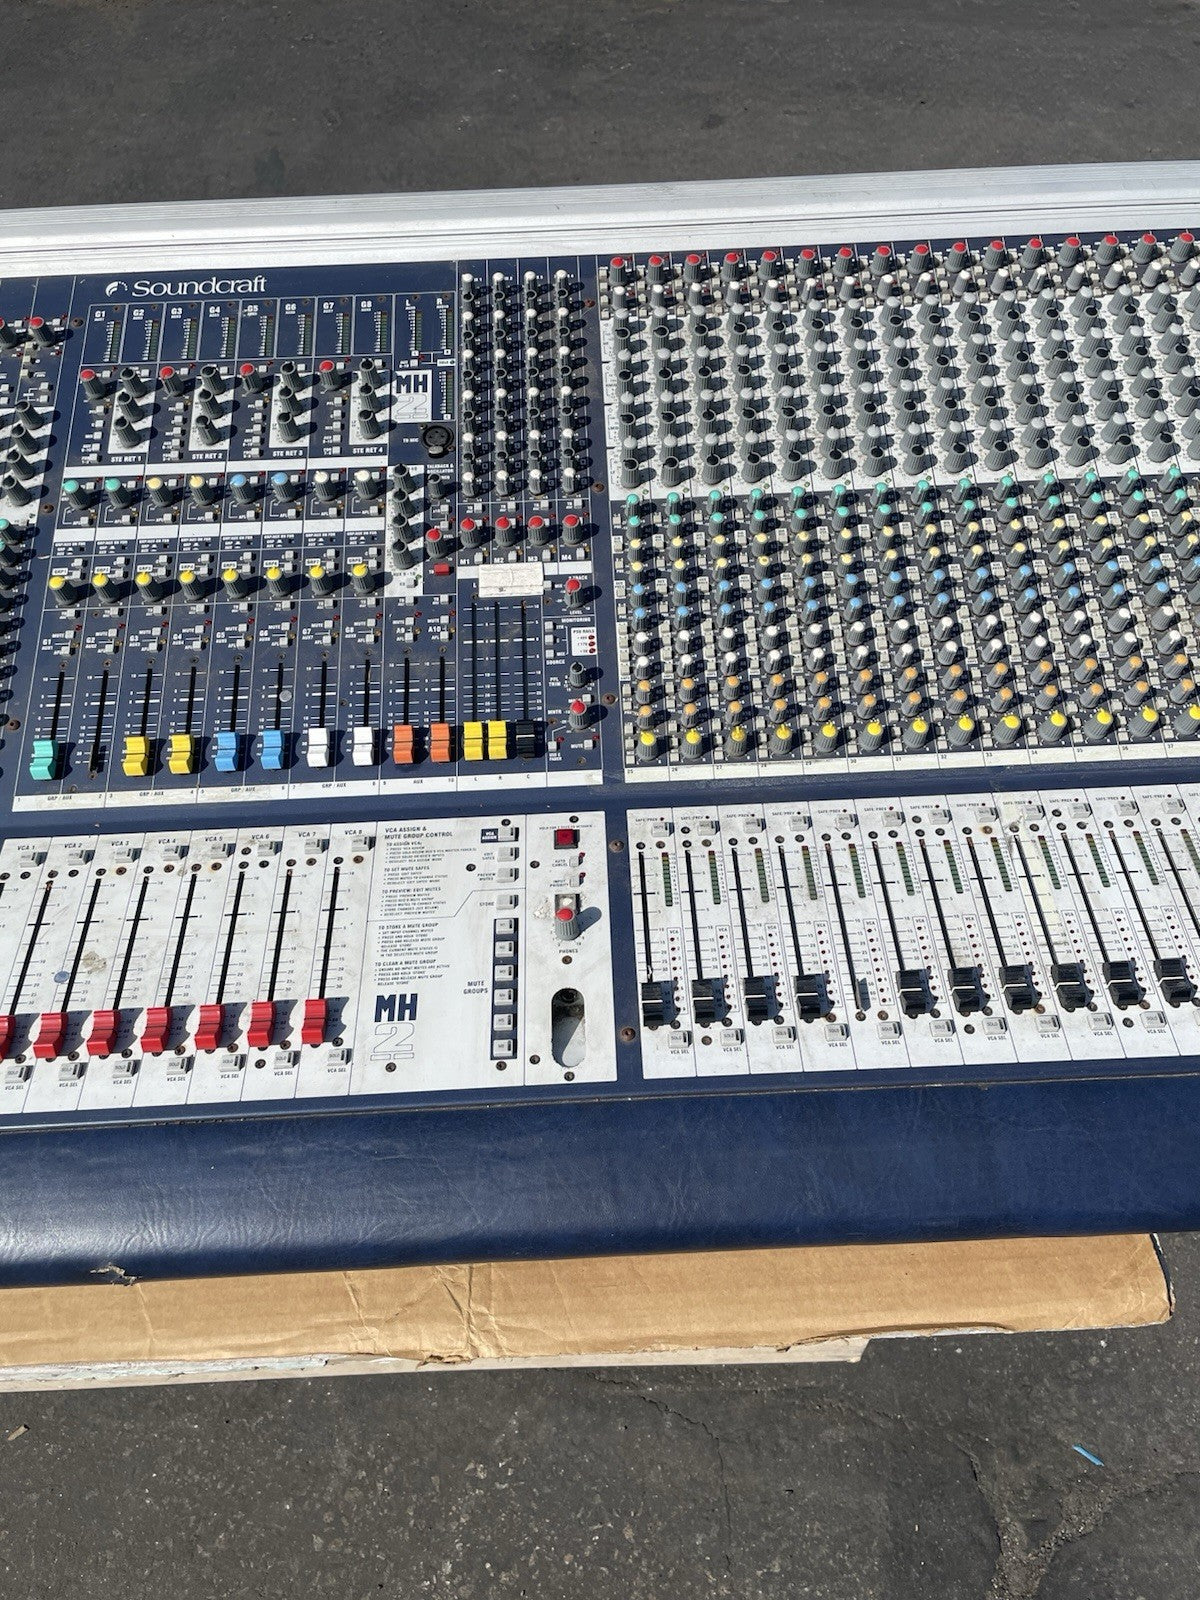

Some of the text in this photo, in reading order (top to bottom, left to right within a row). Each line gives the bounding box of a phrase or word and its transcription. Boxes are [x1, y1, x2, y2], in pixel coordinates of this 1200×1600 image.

[132, 275, 267, 297] Soundcraft
[396, 374, 428, 394] MH
[374, 994, 418, 1022] MH
